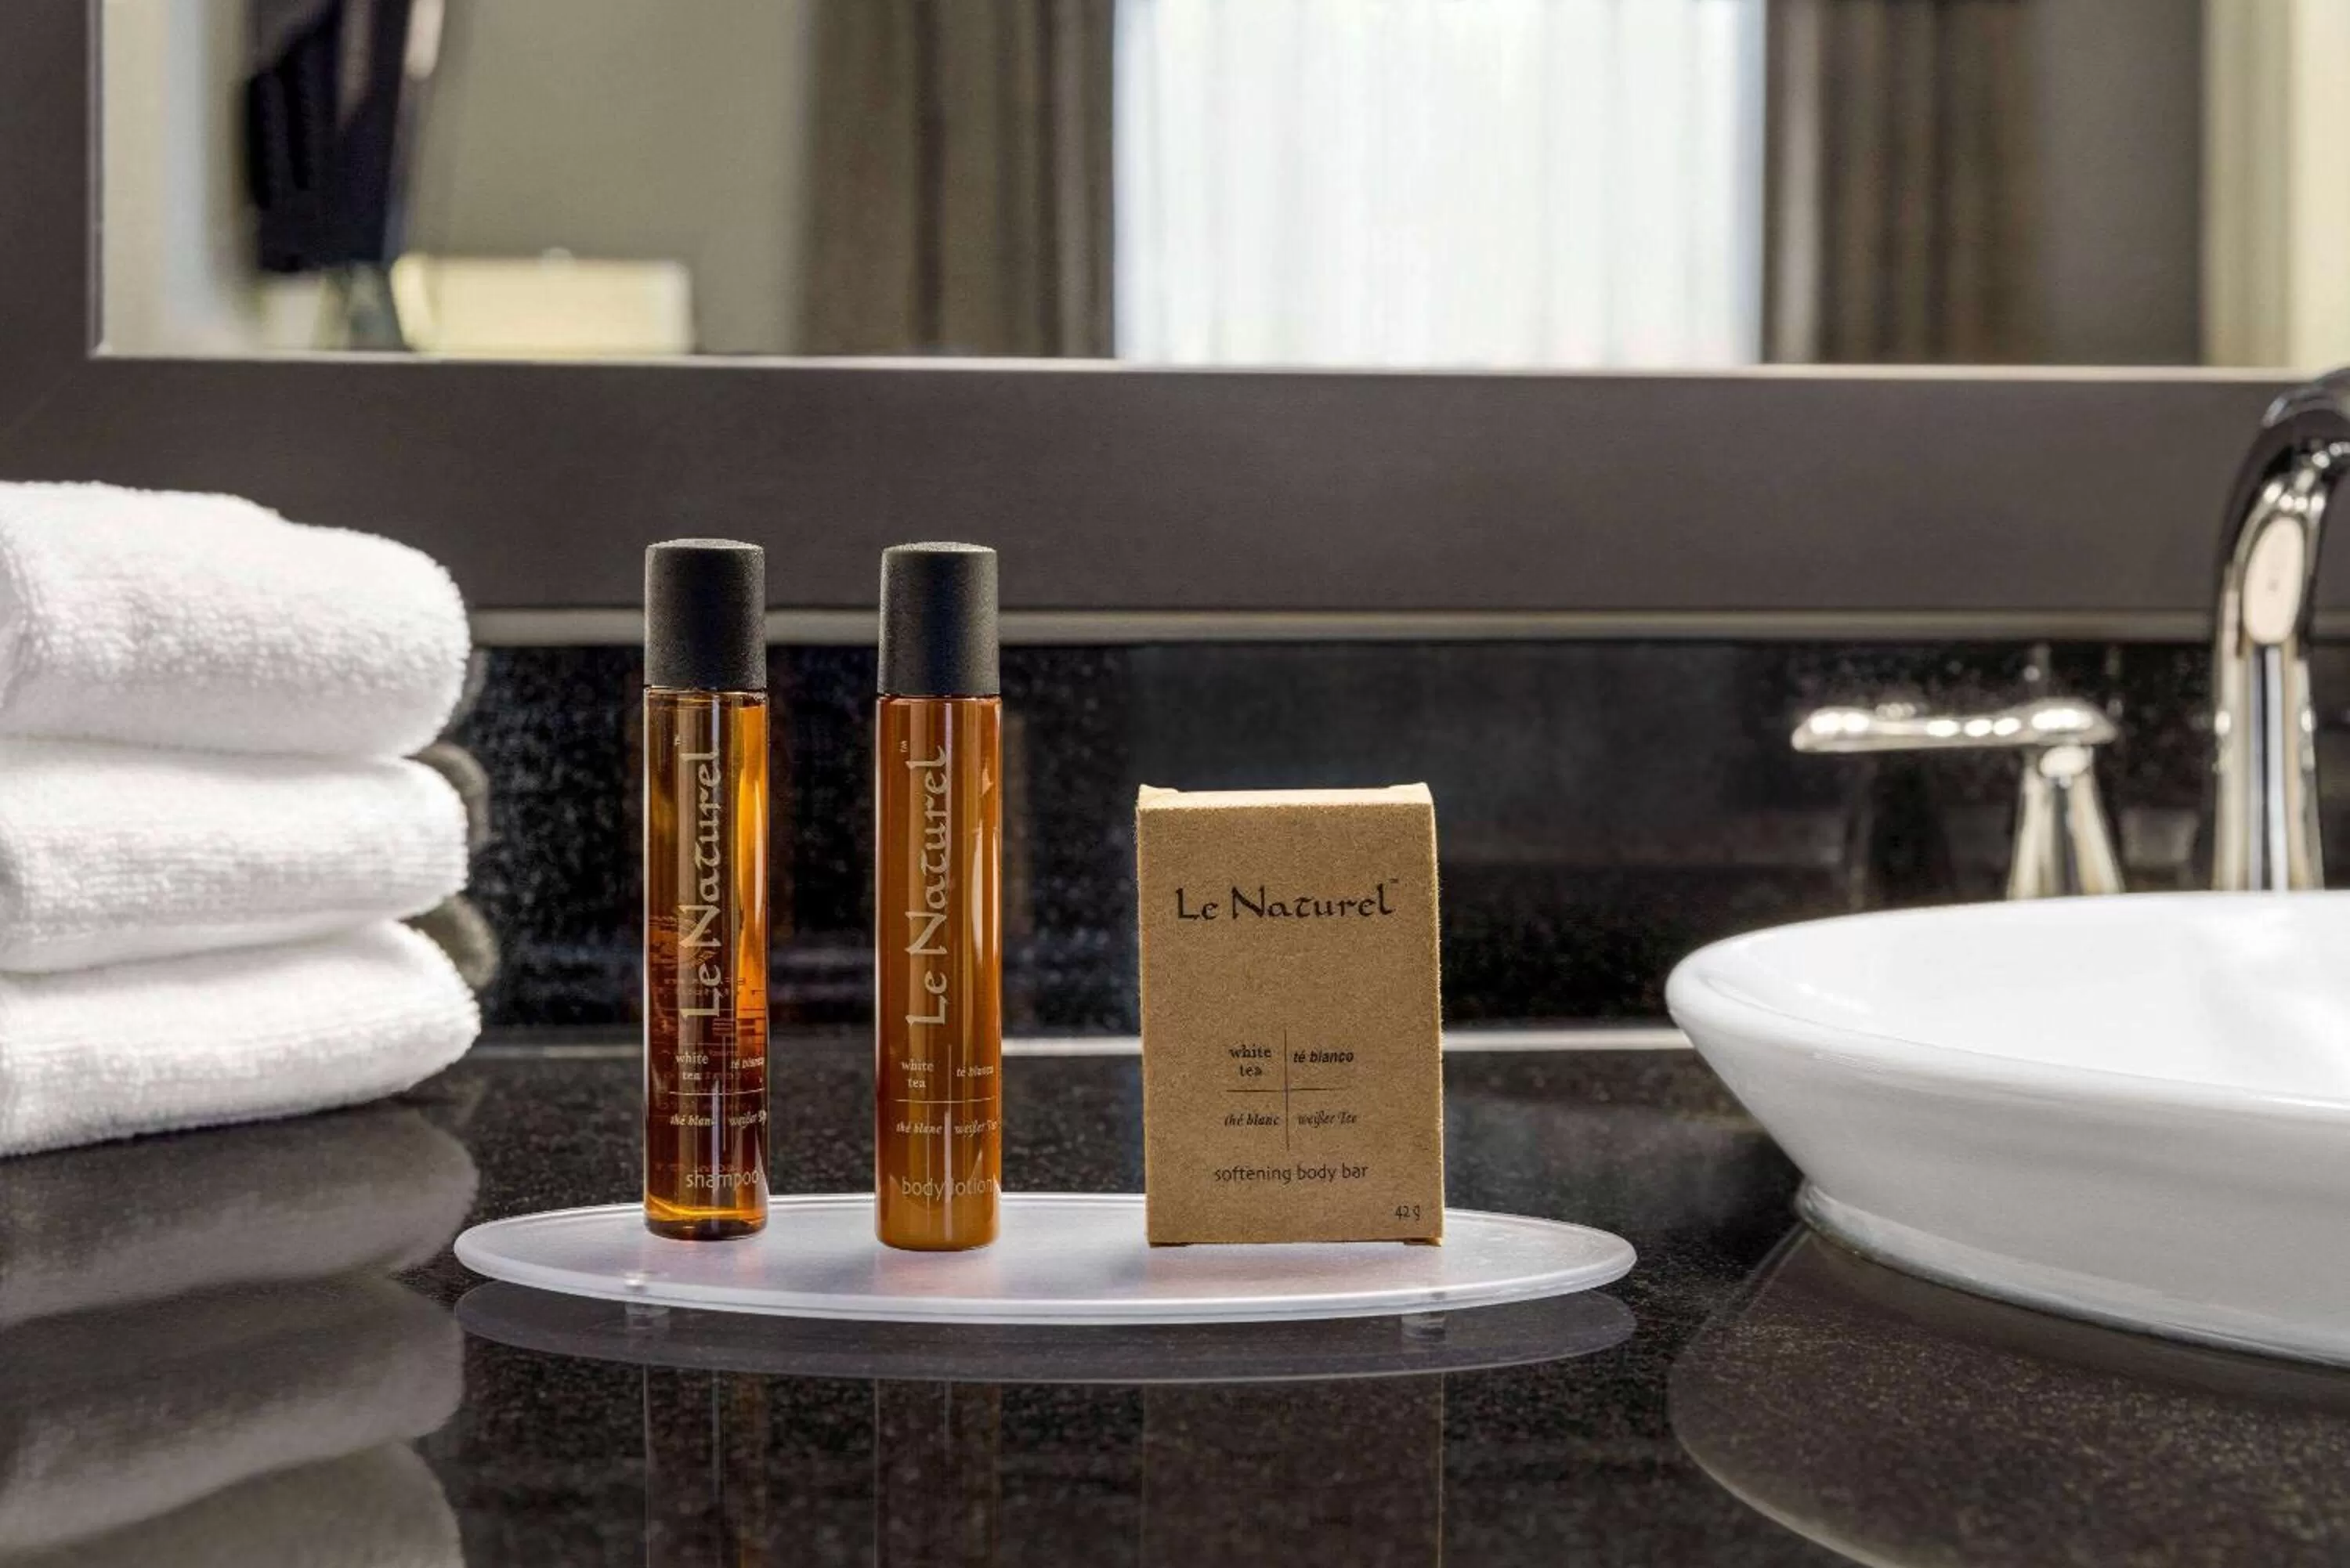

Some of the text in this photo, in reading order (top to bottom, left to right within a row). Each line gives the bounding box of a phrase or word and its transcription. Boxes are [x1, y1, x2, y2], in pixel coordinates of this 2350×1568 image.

[678, 751, 721, 949] Naturel
[905, 745, 949, 1027] Le Naturel
[1176, 883, 1396, 921] Le Naturel
[678, 963, 723, 1020] Le
[675, 1050, 709, 1064] white
[1228, 1043, 1272, 1058] white
[1292, 1049, 1306, 1063] té
[902, 1058, 935, 1072] white
[1239, 1064, 1263, 1077] tea
[682, 1071, 702, 1080] tea
[907, 1078, 926, 1088] tea
[1246, 1113, 1280, 1126] blanc
[913, 1122, 942, 1134] blanc
[685, 1169, 759, 1190] shampoo
[1215, 1162, 1369, 1184] softening body bar
[902, 1176, 945, 1201] body
[1395, 1205, 1421, 1220] 42 g
